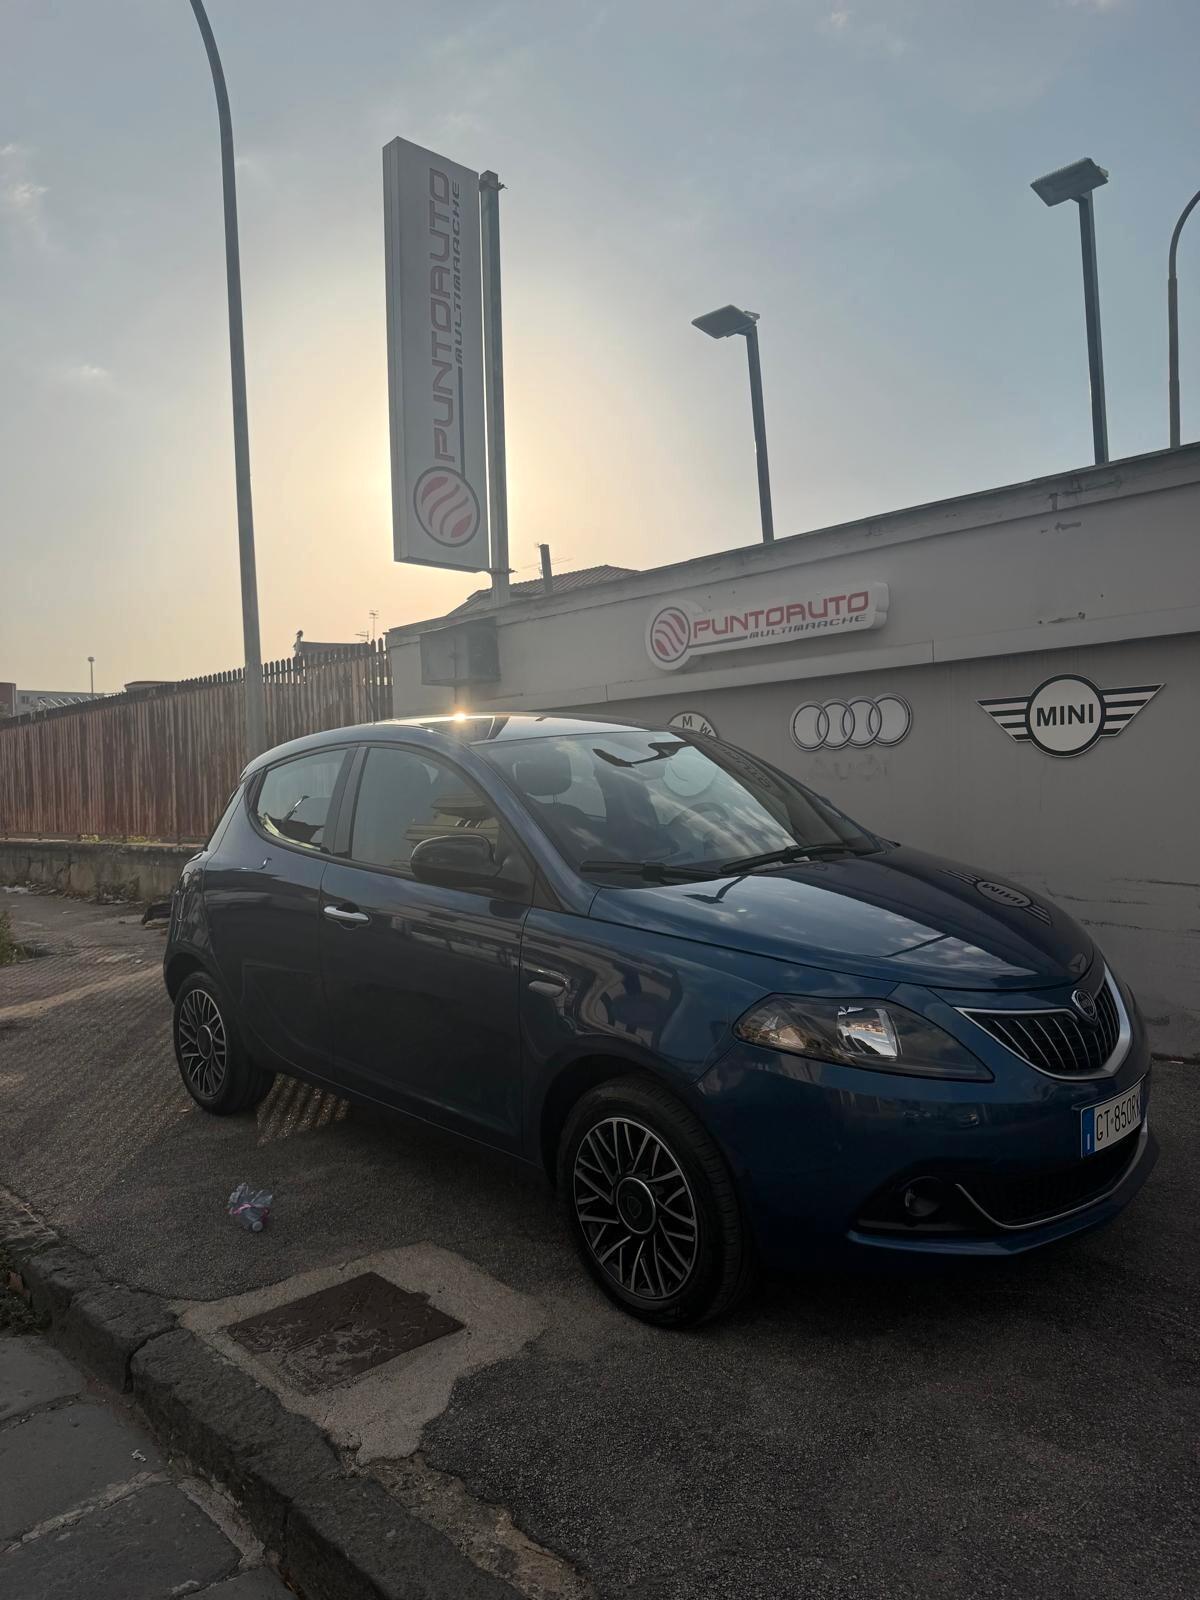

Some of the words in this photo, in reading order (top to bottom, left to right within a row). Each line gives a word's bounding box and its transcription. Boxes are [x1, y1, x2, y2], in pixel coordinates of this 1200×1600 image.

[452, 180, 463, 365] MULTIMARCHE
[429, 168, 455, 462] PUNTOAUTO
[693, 591, 869, 638] PUNTOAUTO
[749, 614, 867, 639] MULTIMARCHE
[683, 715, 711, 736] MW
[1036, 703, 1094, 727] MINI
